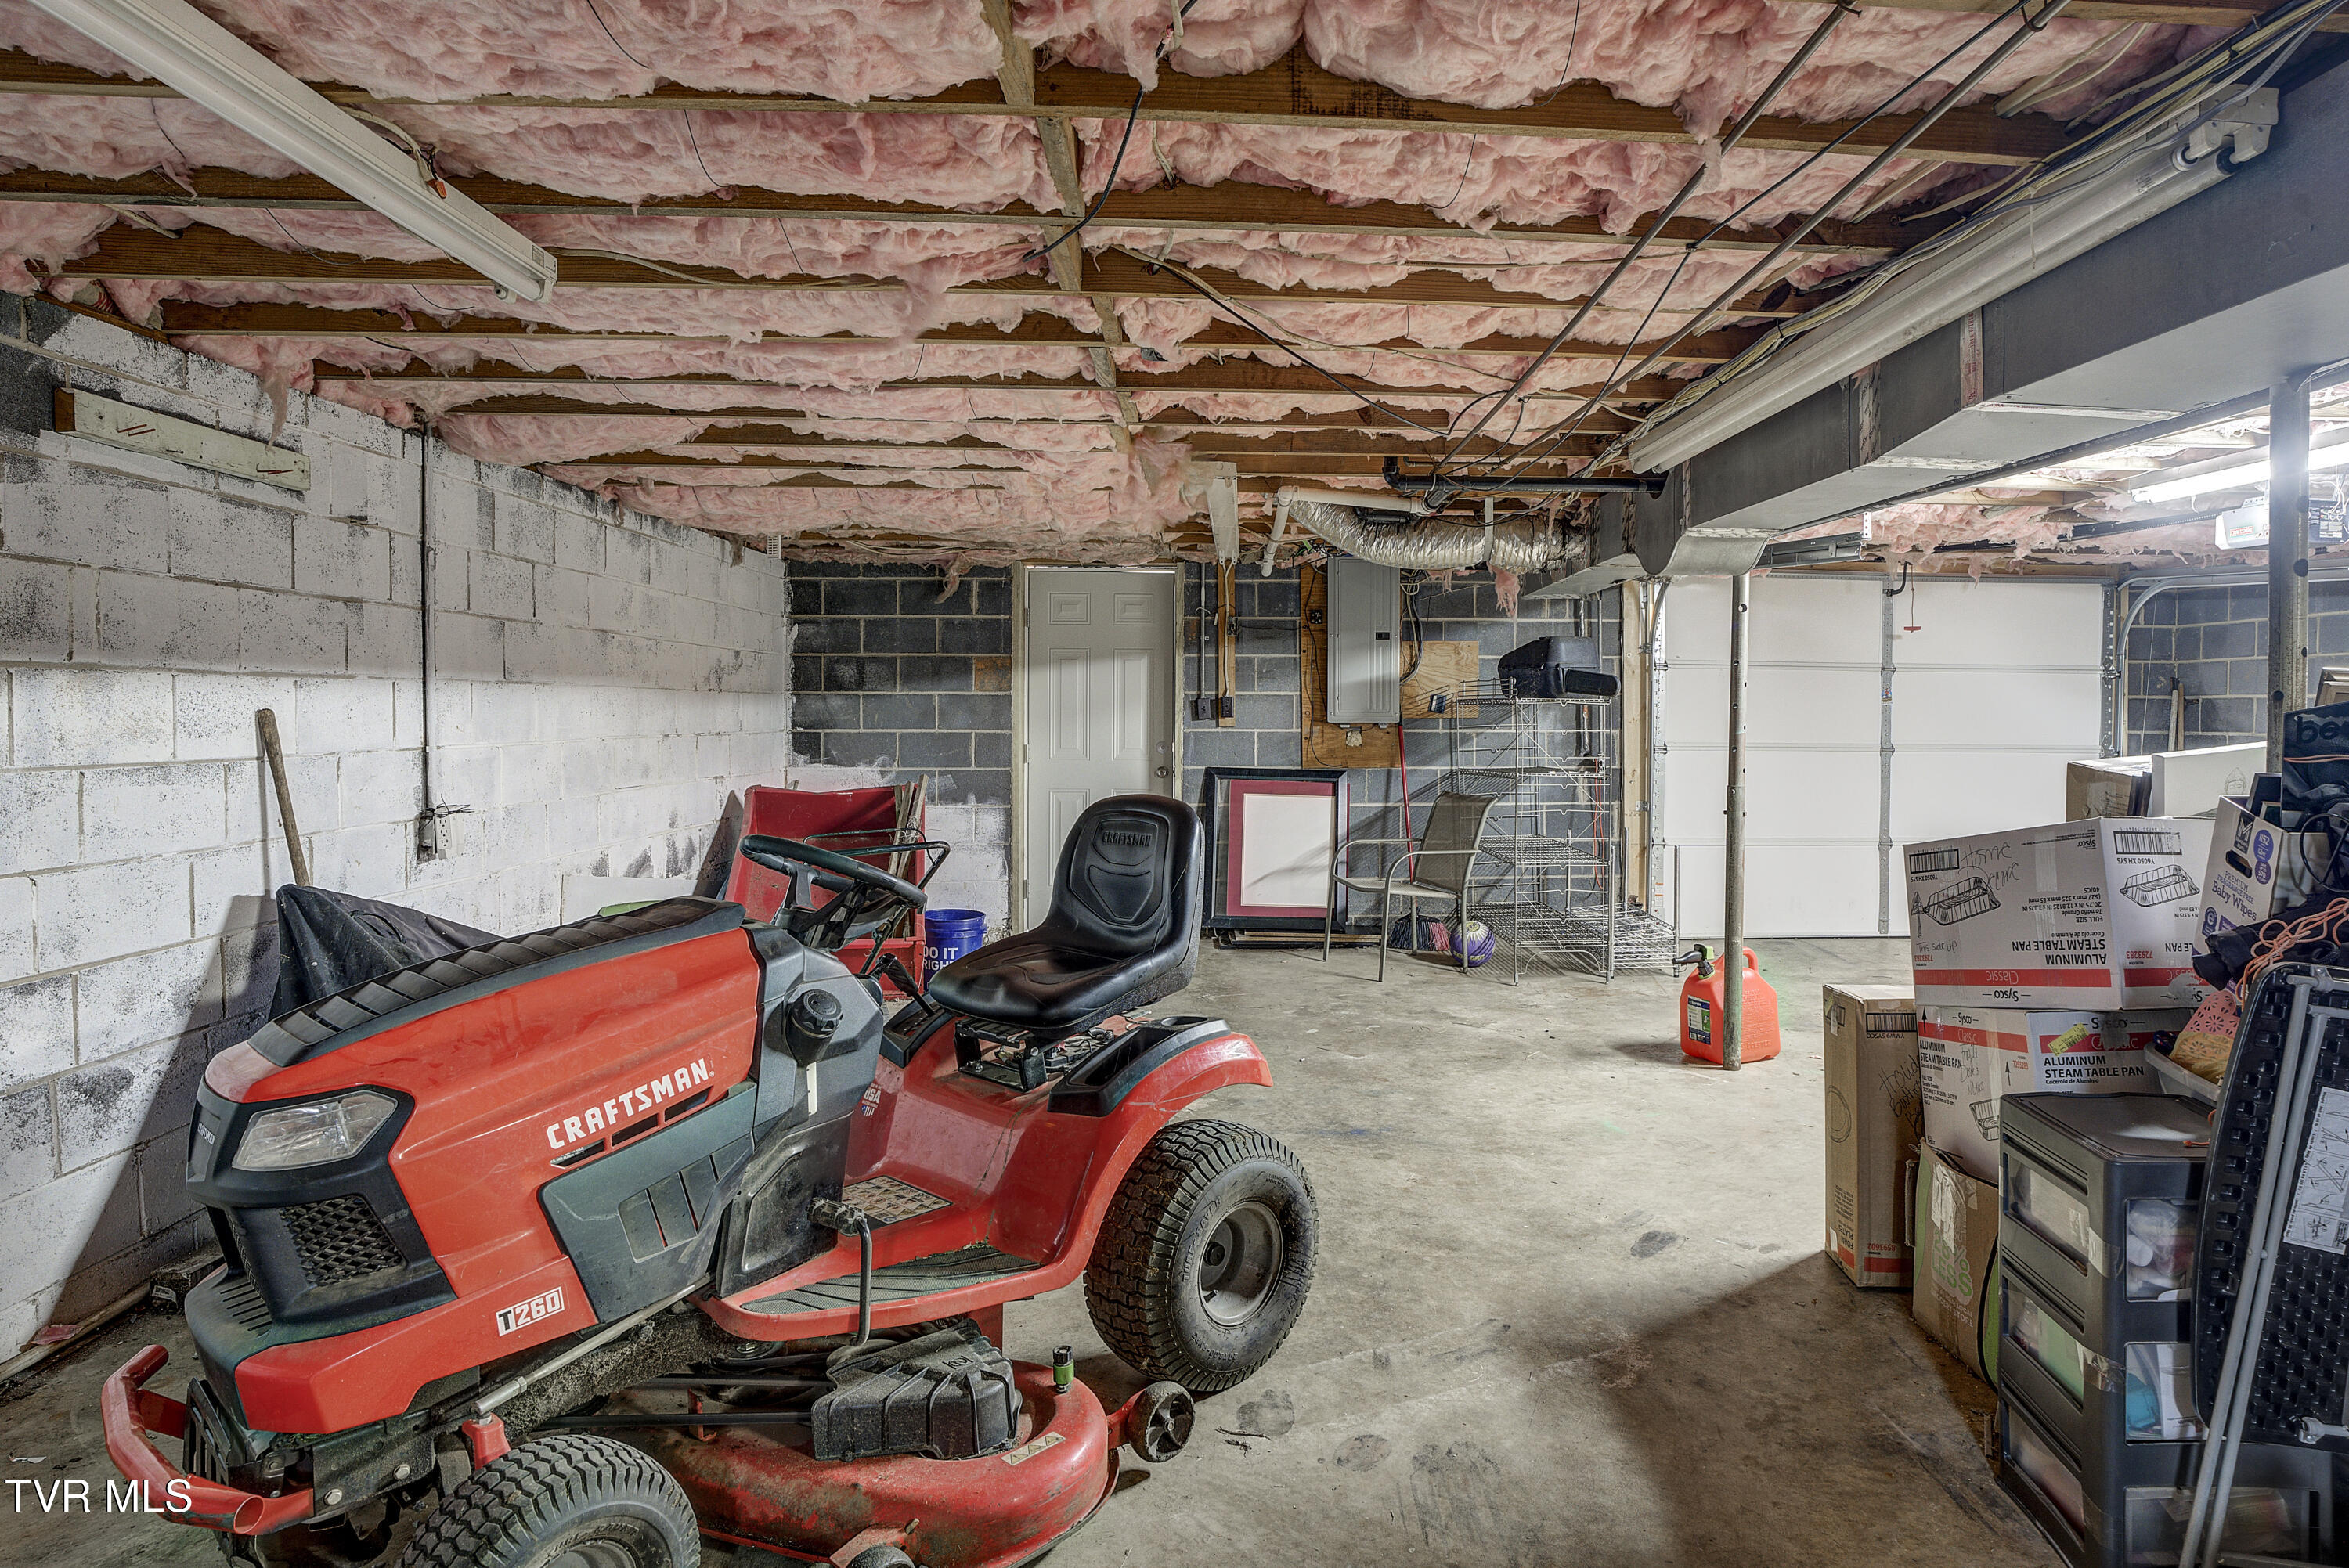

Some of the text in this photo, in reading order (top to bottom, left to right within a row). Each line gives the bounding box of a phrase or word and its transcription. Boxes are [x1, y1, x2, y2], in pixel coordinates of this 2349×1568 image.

[1102, 831, 1153, 847] CRAFTSMAN
[2225, 871, 2249, 892] PREMIUM
[2212, 880, 2257, 921] Baby Wipes
[1916, 941, 1930, 953] This
[1932, 939, 1946, 951] side
[2012, 939, 2105, 951] STEAM TABLE PAN
[2165, 943, 2182, 952] PAN
[924, 946, 958, 960] DO IT
[2045, 953, 2107, 965] ALUMINUM
[2126, 950, 2153, 959] 7293283
[924, 960, 955, 971] RIGH
[1986, 971, 2019, 984] Classic
[1994, 989, 2019, 1001] Sysco
[1958, 1012, 1972, 1026] Sysco
[1958, 1029, 1977, 1044] Classic
[1920, 1040, 1946, 1053] ALUMINUM
[1920, 1052, 1961, 1069] STEAM TABLE PAN
[2044, 1055, 2106, 1066] ALUMINUM
[1879, 1054, 1919, 1100] Holid
[2045, 1066, 2144, 1079] STEAM TABLE PAN
[864, 1087, 882, 1104] USA
[546, 1058, 710, 1150] CRAFTSMAN
[198, 1121, 216, 1145] CRAFTSMAN
[1838, 1225, 1853, 1241] PLATES
[1841, 1238, 1854, 1250] FOAM
[1867, 1242, 1896, 1252] 8593602
[1932, 1248, 1973, 1297] LESS
[498, 1291, 561, 1331] T260
[1953, 1308, 1973, 1328] STORE
